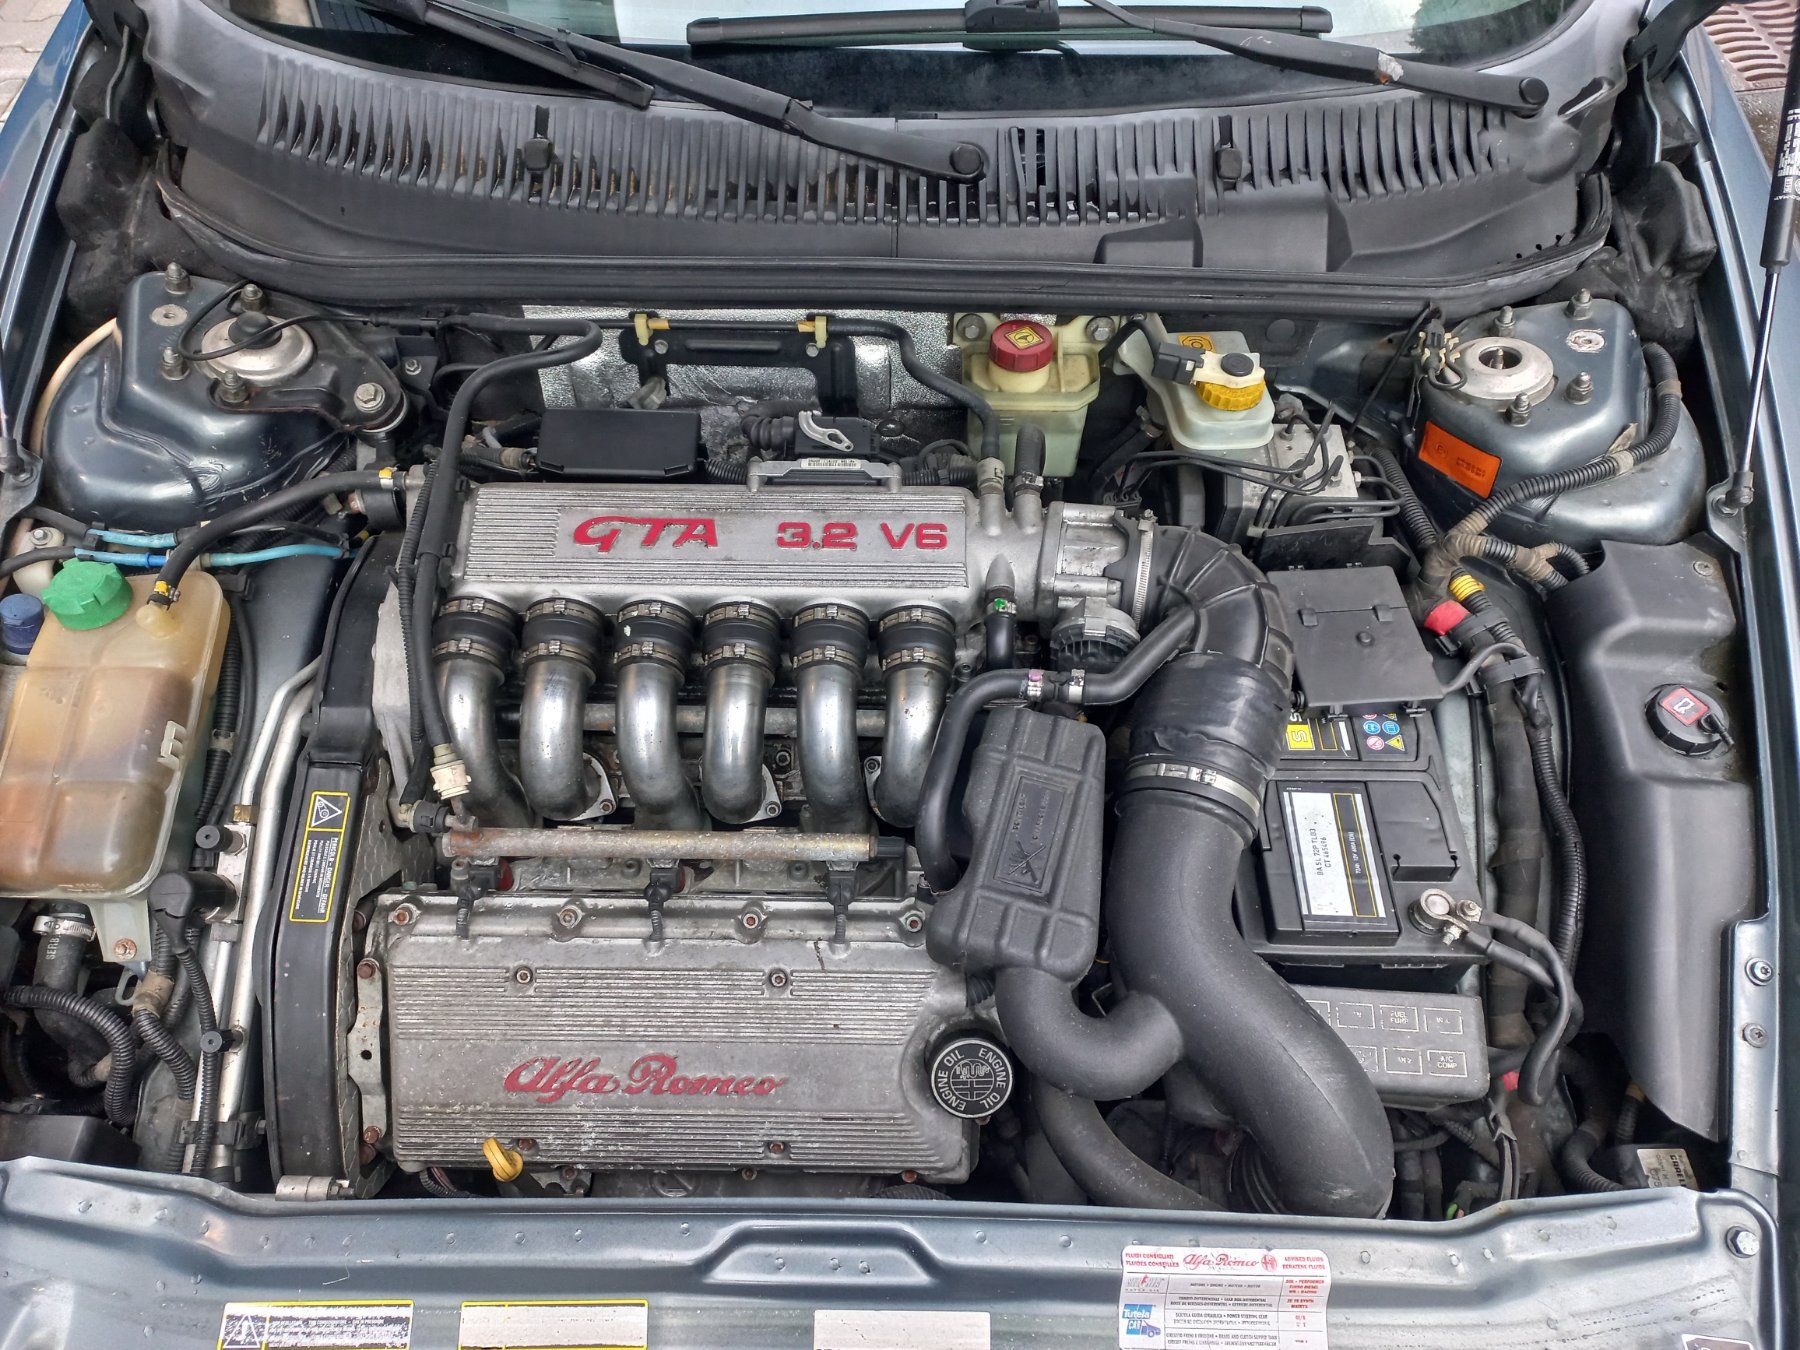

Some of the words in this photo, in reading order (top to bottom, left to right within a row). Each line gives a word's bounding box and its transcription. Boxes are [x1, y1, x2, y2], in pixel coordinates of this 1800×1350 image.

[574, 515, 718, 553] GTA
[776, 521, 858, 550] 3.2
[880, 522, 949, 550] V6
[944, 1049, 964, 1066] OIL
[978, 1048, 1007, 1089] ENGINE
[503, 1056, 620, 1102] Alfa
[622, 1052, 790, 1096] Romeo
[938, 1070, 966, 1111] ENGINE
[980, 1092, 1000, 1109] OIL
[1182, 1253, 1214, 1271] Alfa
[1214, 1253, 1260, 1268] Romeo
[1122, 1307, 1151, 1320] Tutela
